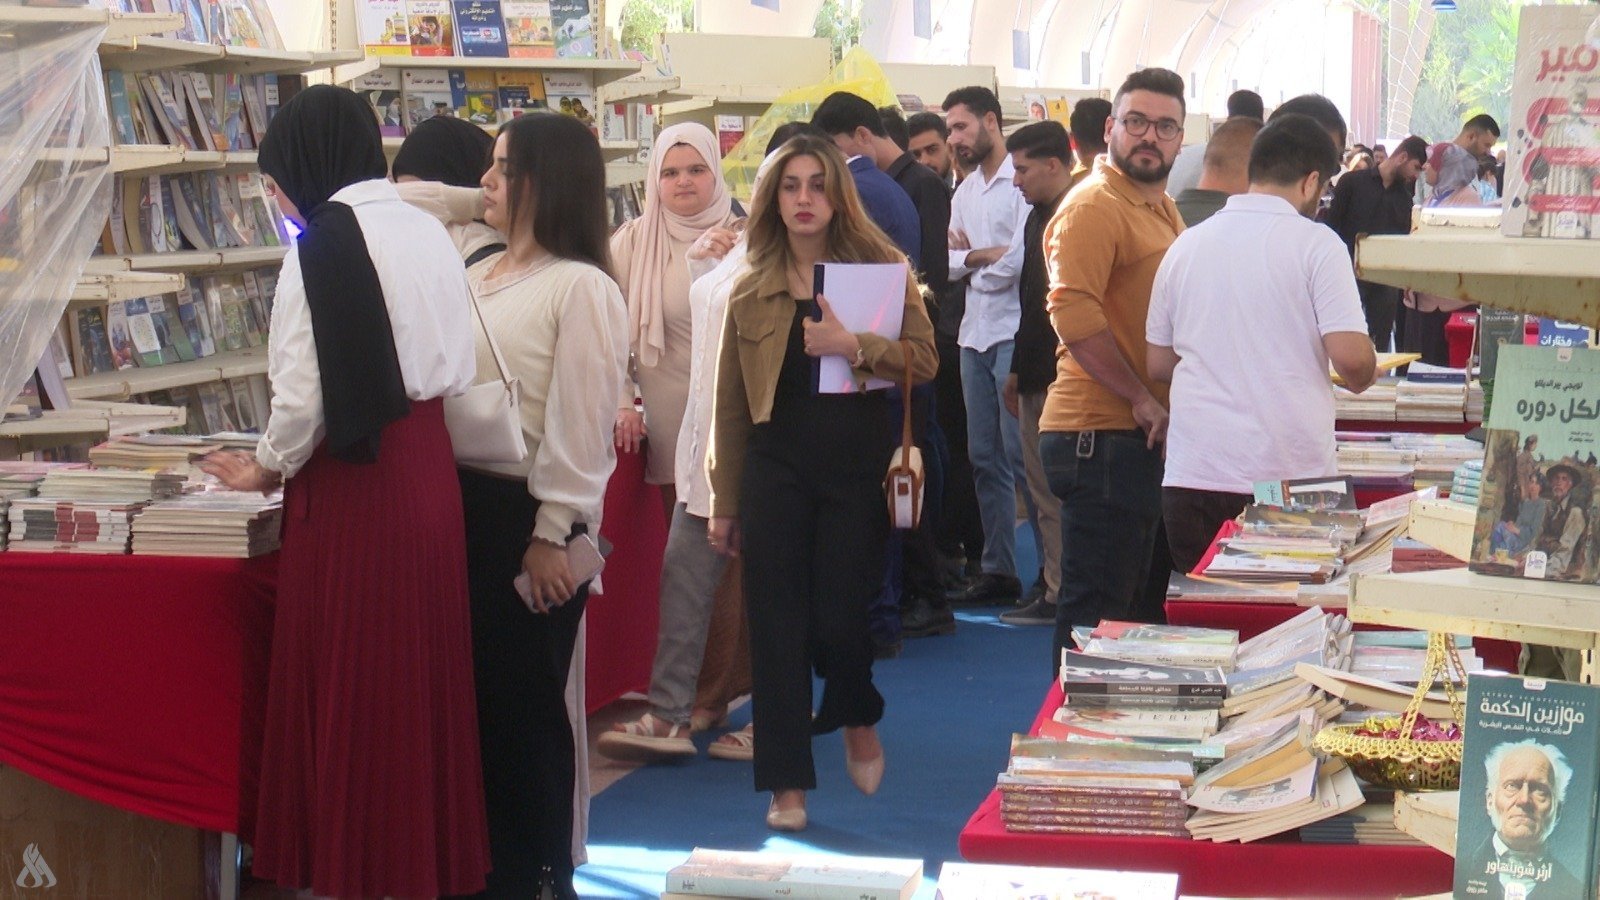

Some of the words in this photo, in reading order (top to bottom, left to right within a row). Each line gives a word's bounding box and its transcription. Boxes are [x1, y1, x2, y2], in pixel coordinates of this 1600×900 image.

[1540, 335, 1573, 347] مختارات
[1560, 398, 1600, 423] لكل
[1480, 698, 1531, 723] الحكمة
[1533, 706, 1585, 735] موازين
